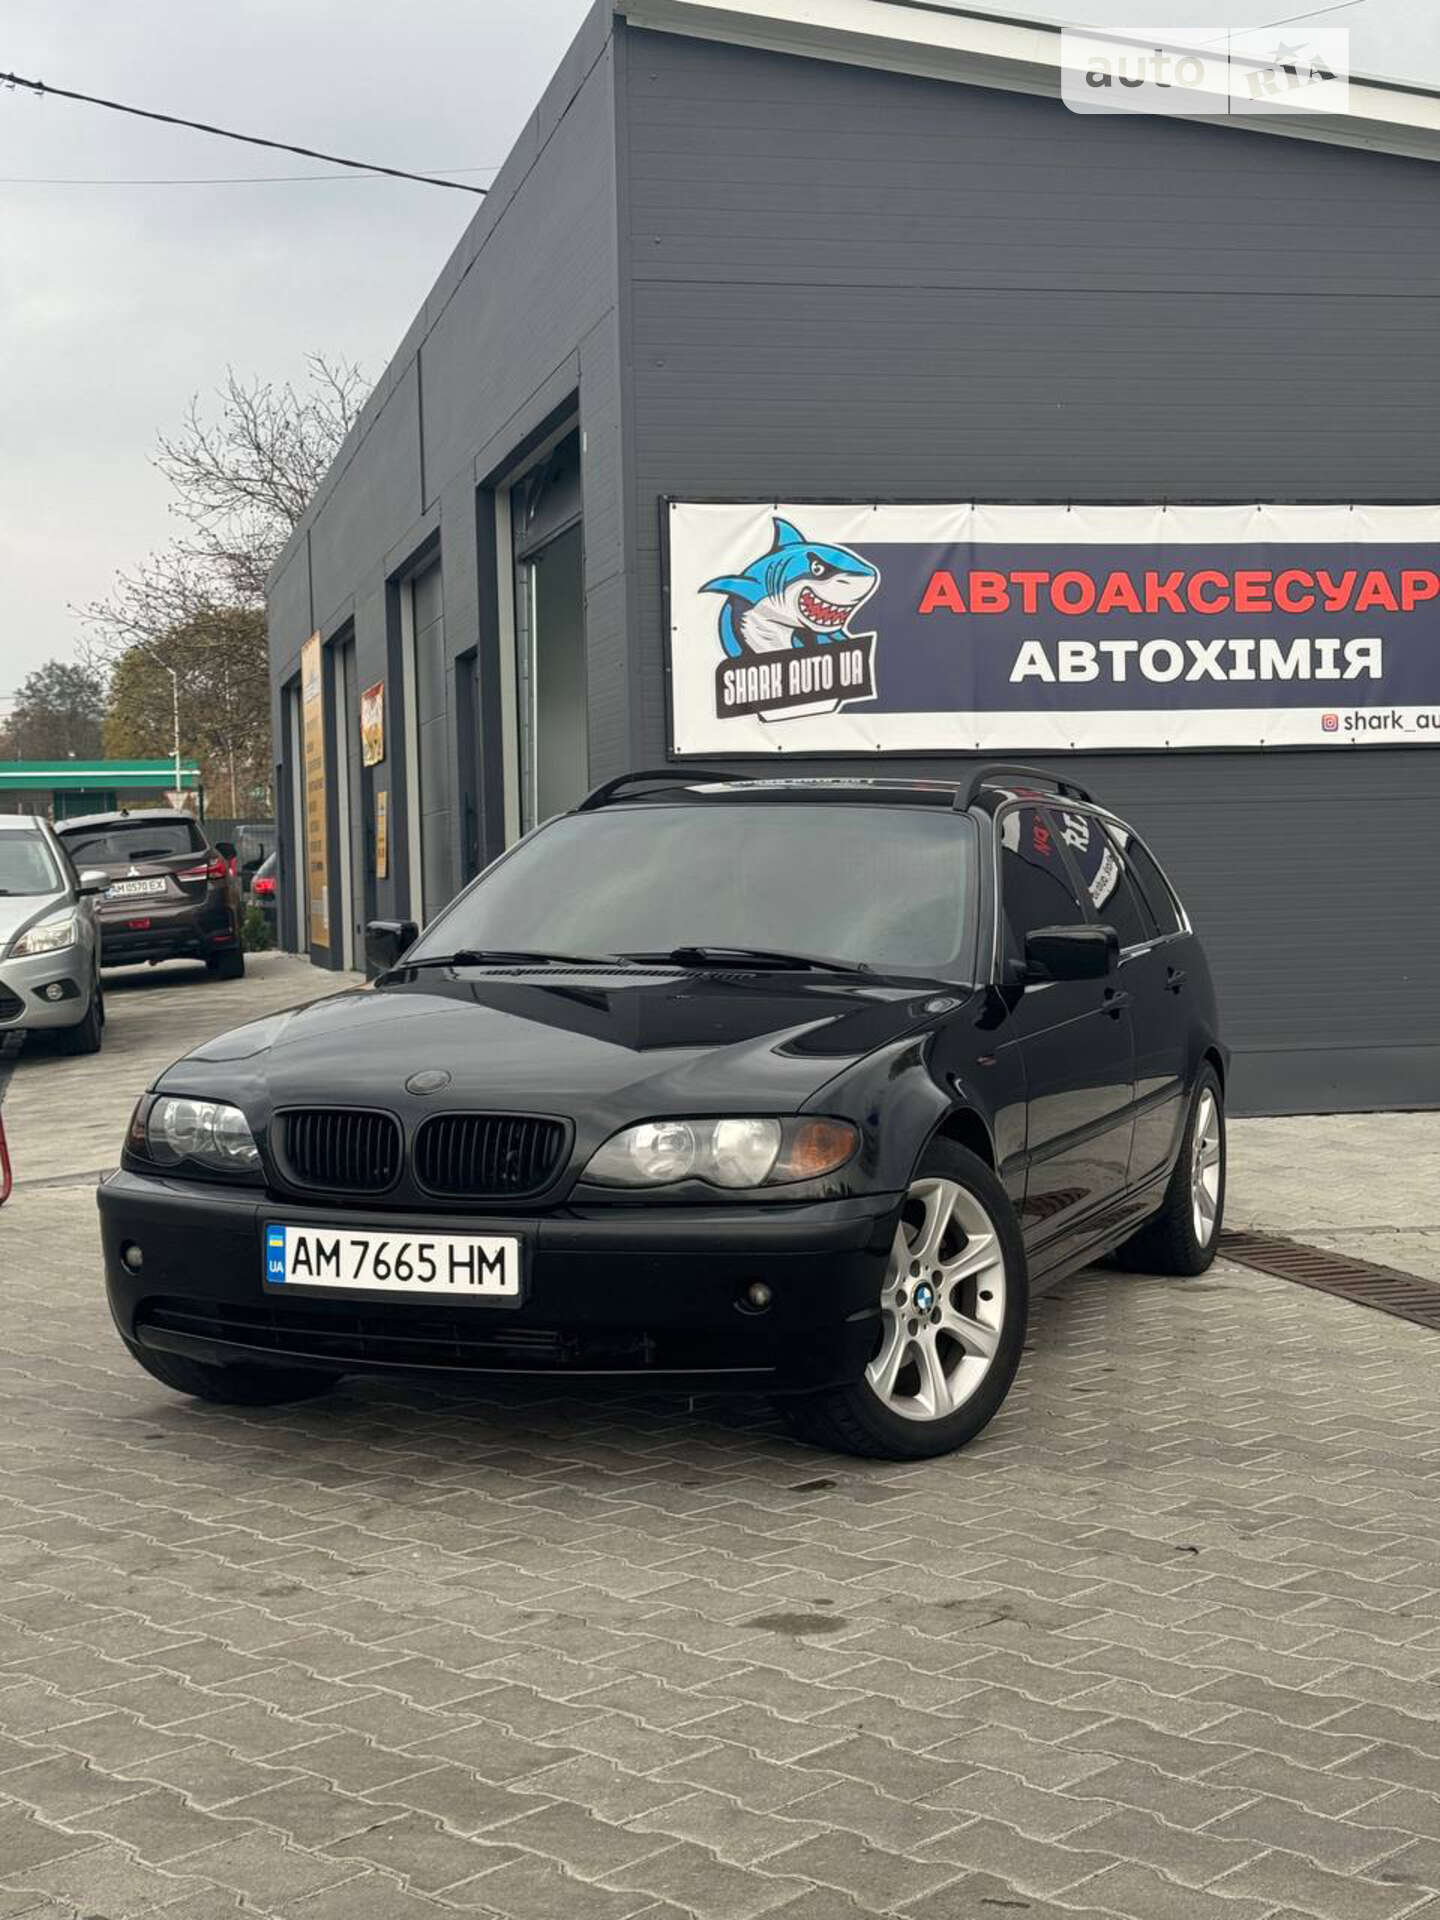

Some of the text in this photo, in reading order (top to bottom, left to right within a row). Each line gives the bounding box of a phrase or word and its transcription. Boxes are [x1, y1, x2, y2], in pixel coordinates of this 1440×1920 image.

[918, 569, 1440, 614] АВТОАКСЕСУАР
[723, 649, 864, 706] SHARK AUTO UA
[1008, 637, 1384, 683] АВТОХІМІЯ
[269, 1260, 285, 1273] UA
[291, 1236, 506, 1286] AM 7665 HM
